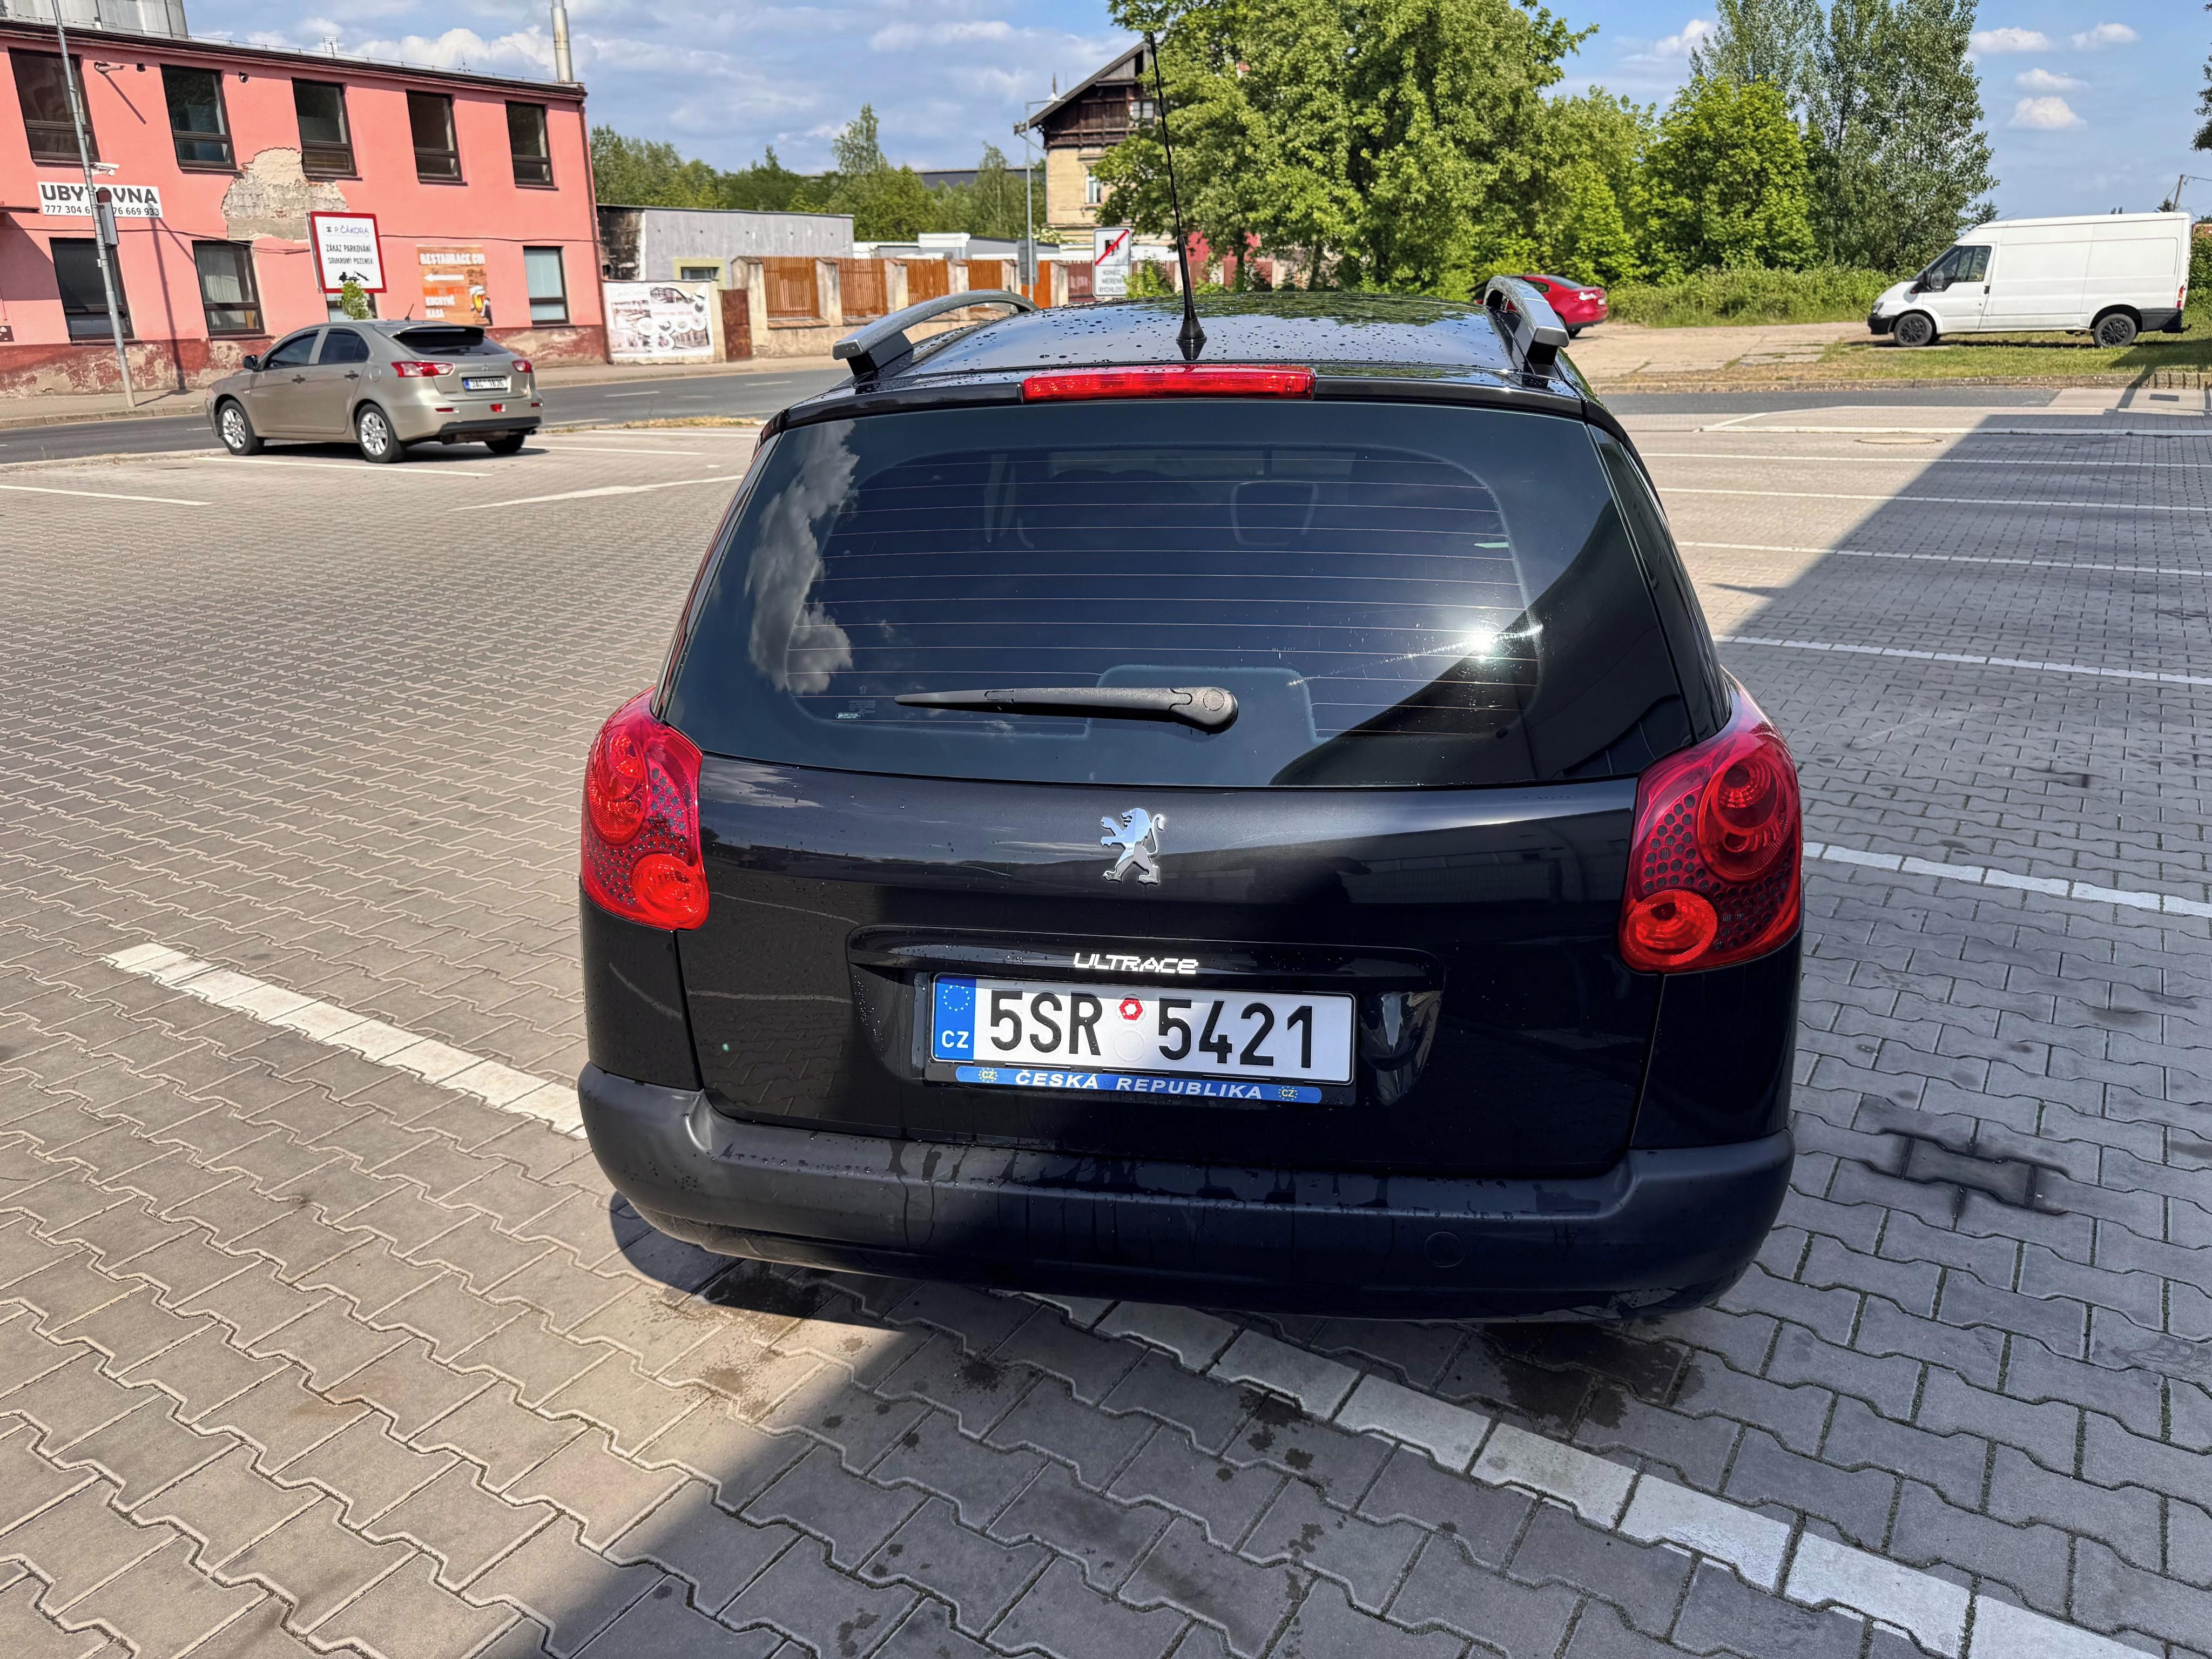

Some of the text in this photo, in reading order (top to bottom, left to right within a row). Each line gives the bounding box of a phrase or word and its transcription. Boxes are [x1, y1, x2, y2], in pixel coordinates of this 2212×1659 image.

[41, 185, 158, 204] UBYVNA
[941, 1030, 969, 1049] CZ
[990, 989, 1312, 1069] 5SR 5421
[982, 1069, 1294, 1100] CZ ČESKÁ REPUBLIKA CZ
